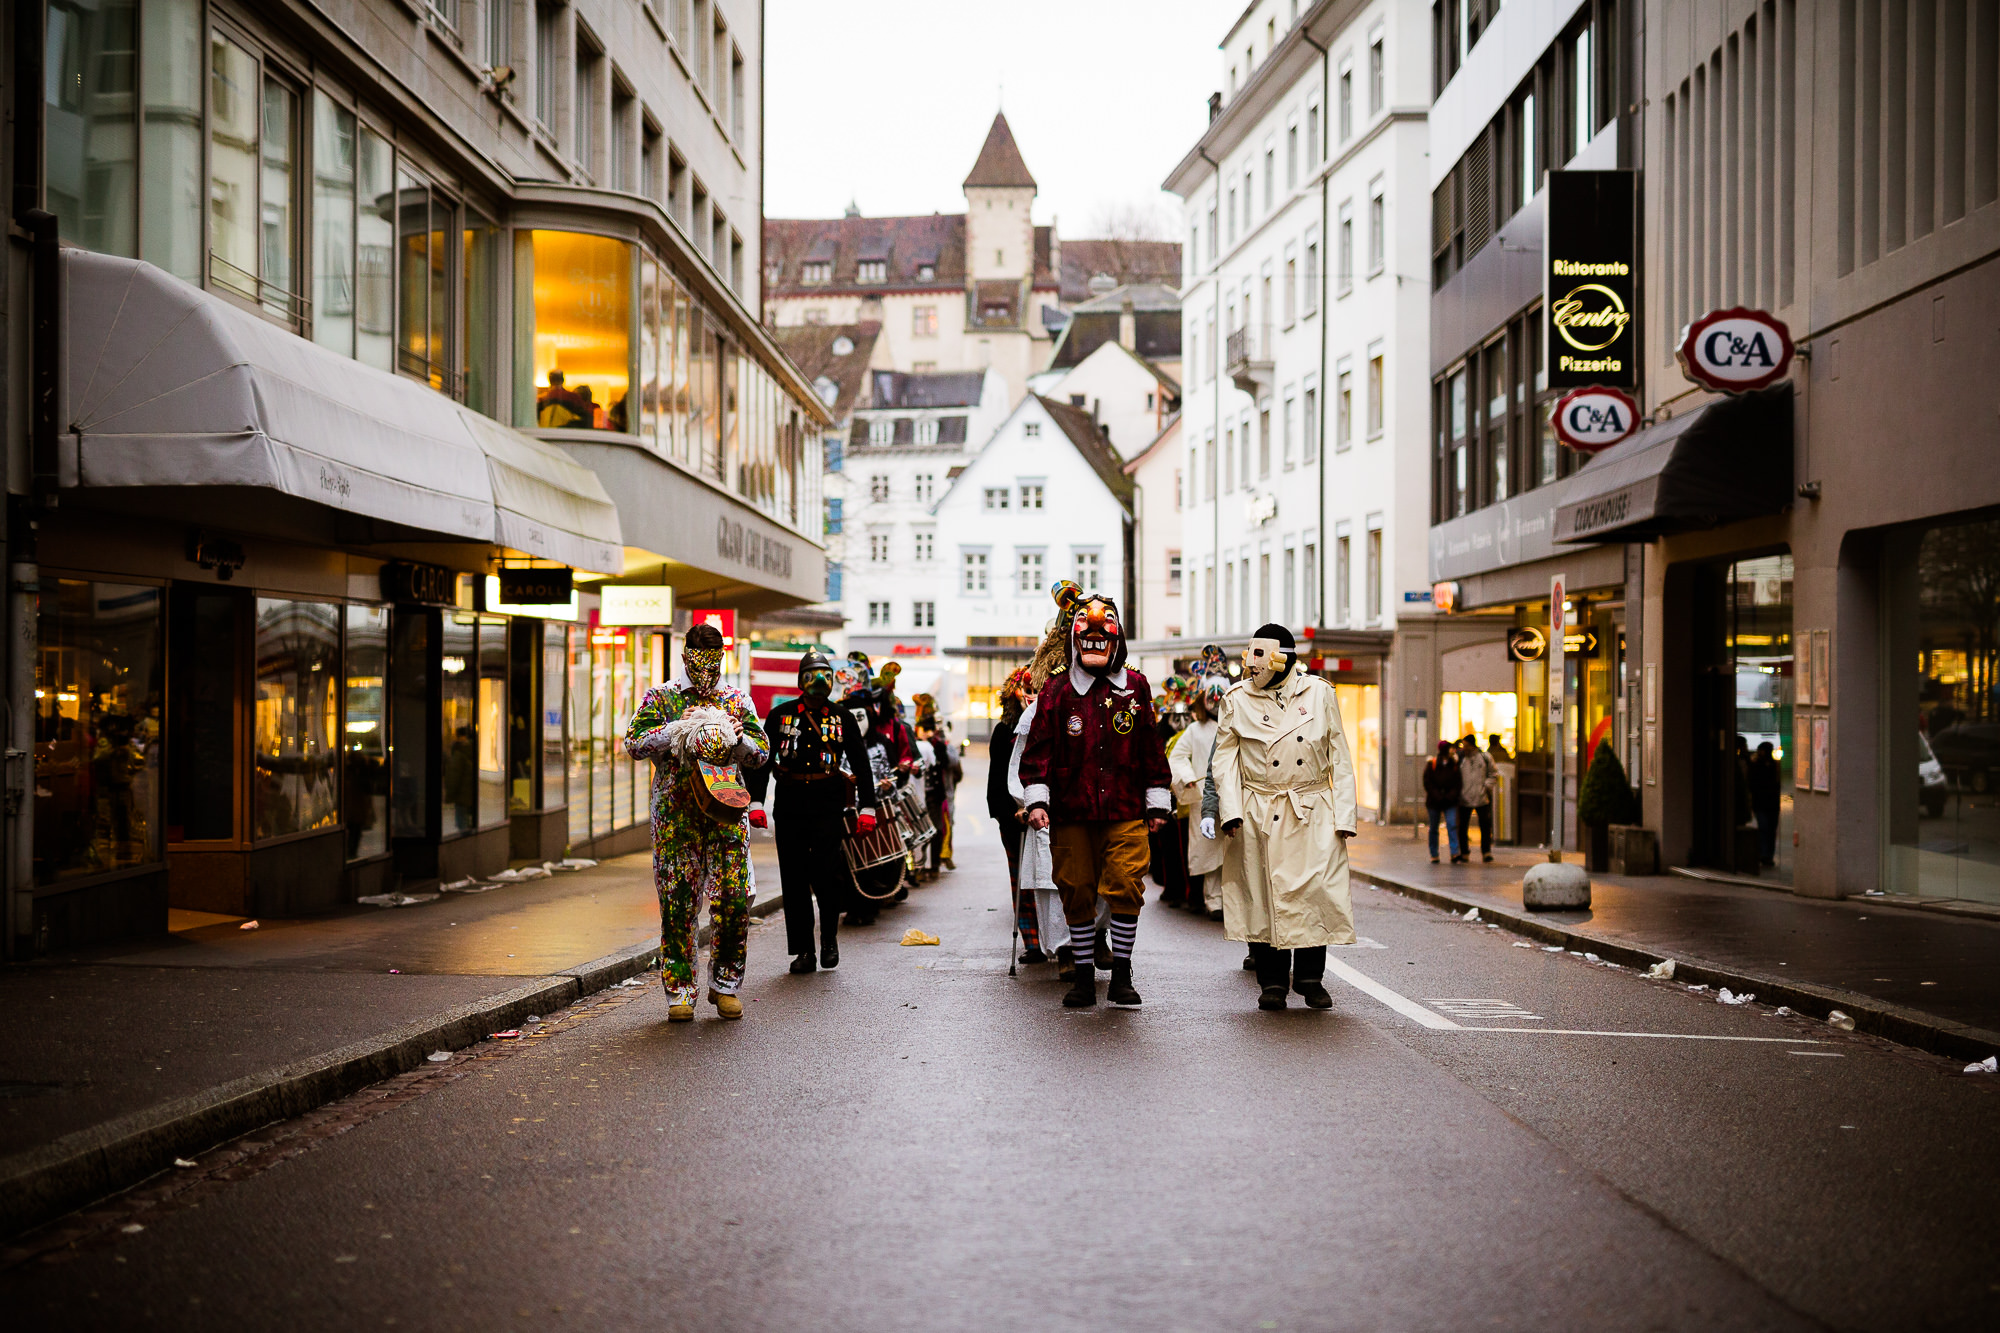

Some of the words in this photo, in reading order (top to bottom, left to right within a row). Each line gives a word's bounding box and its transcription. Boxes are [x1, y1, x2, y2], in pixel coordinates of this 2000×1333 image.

[1553, 259, 1629, 276] Ristorante
[1704, 331, 1775, 367] C&A
[1560, 355, 1622, 372] Pizzeria
[1569, 404, 1625, 434] C&A
[1574, 493, 1628, 532] CLOCKHOUSE
[503, 584, 564, 597] CAROLL
[609, 598, 662, 609] GEOX
